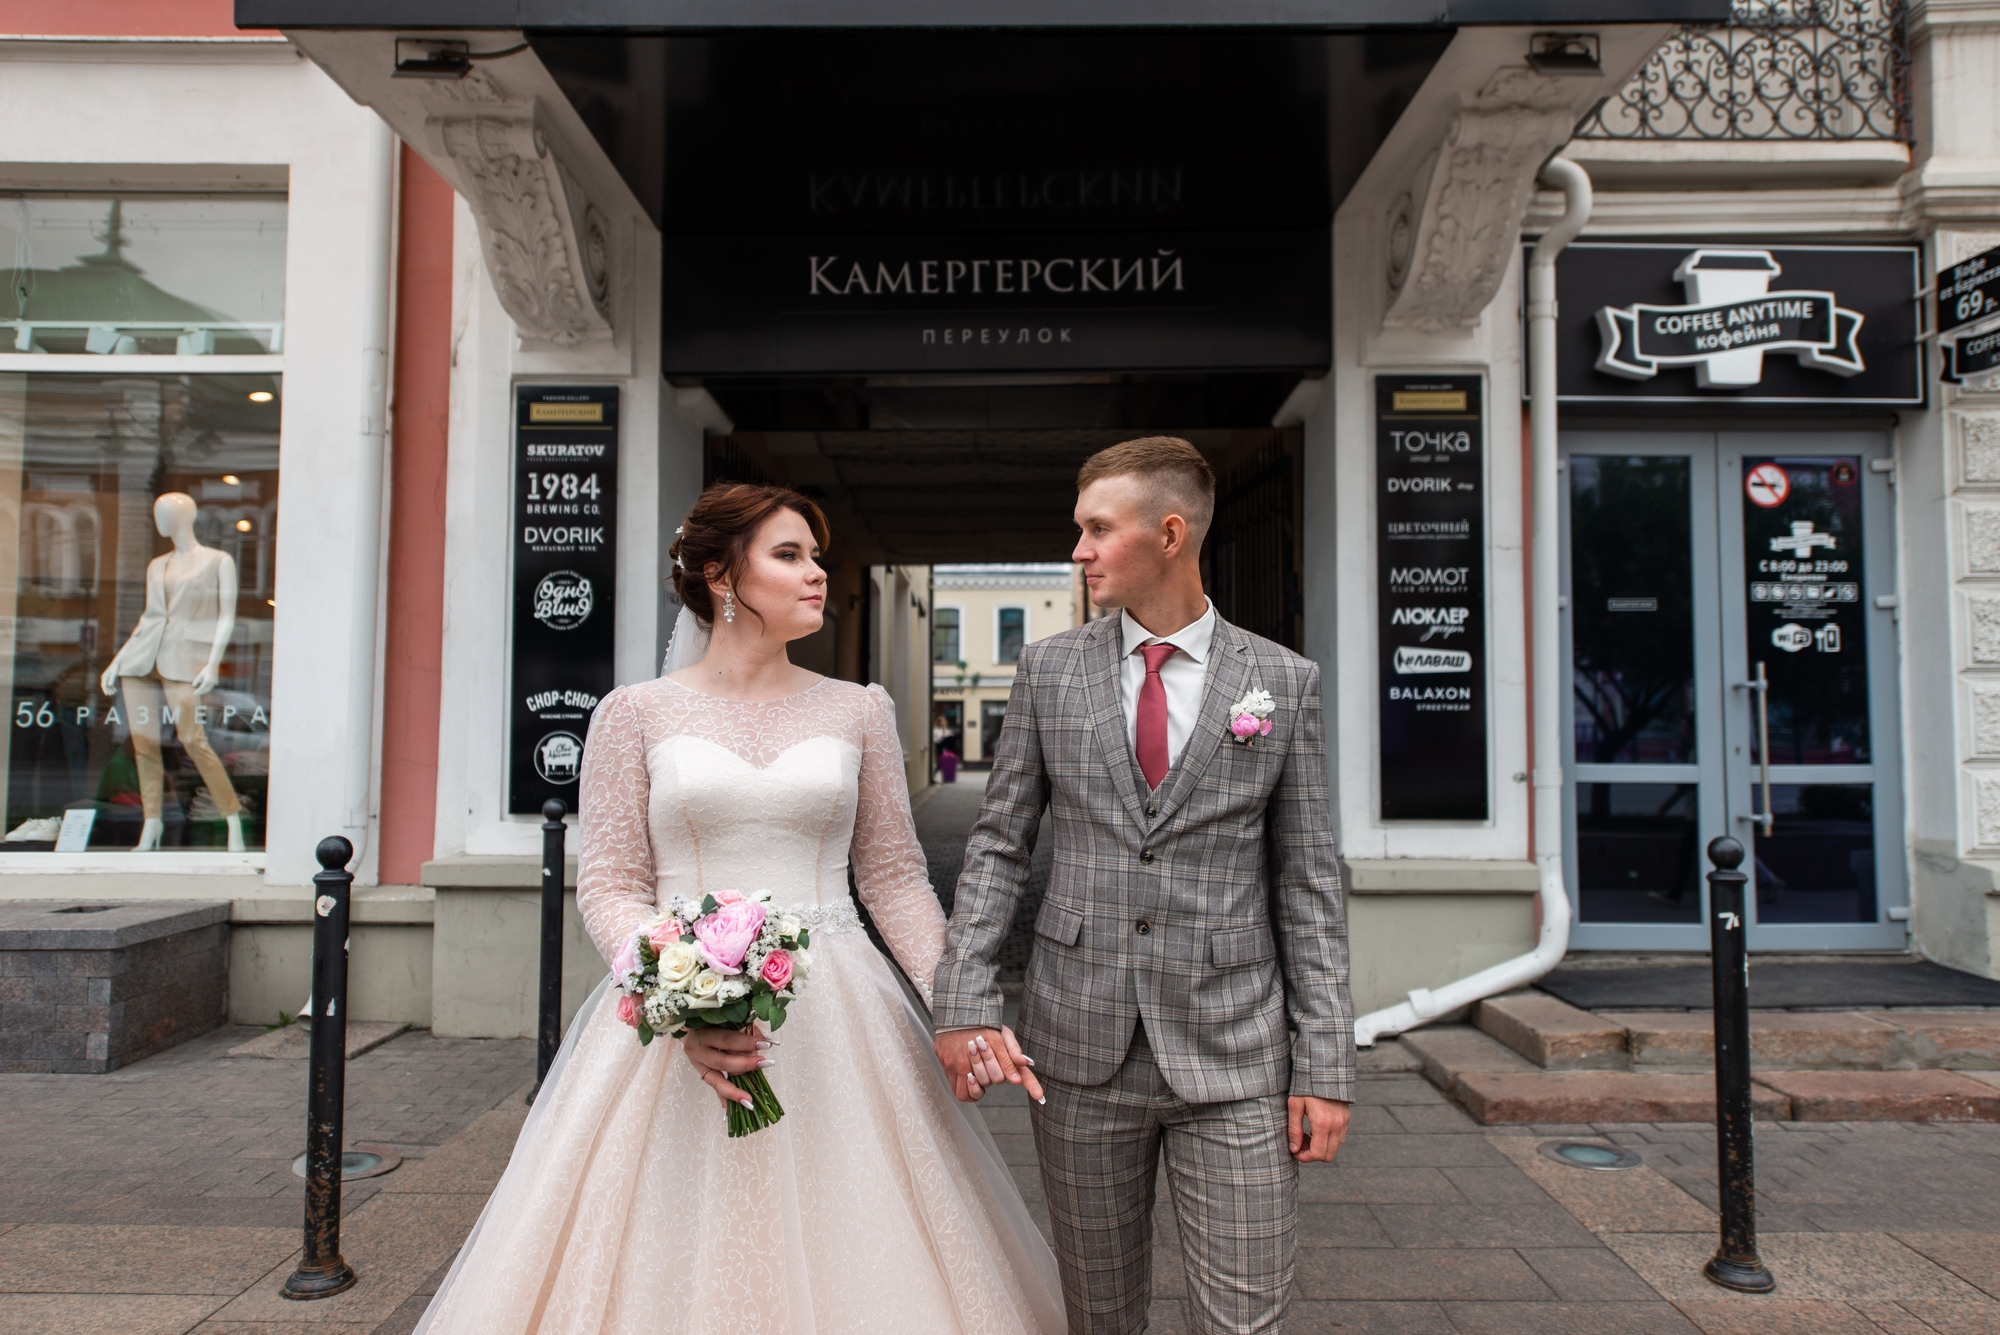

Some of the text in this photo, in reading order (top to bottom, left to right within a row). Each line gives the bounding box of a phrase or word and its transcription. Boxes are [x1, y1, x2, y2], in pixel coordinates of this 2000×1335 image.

[1956, 288, 1984, 321] 69
[1654, 300, 1814, 335] COFFEE ANYTIME
[922, 328, 1072, 344] ПЕРЕУЛОК
[1695, 322, 1780, 351] кофейня
[527, 444, 605, 456] SKURATOV
[527, 472, 601, 500] 1984
[1387, 477, 1452, 492] DVORIK
[527, 504, 600, 515] BREWING CO.
[1388, 518, 1470, 535] ЦВЕТОЧНЫЙ
[524, 527, 604, 544] DVORIK
[1815, 560, 1848, 573] 23:00
[1390, 567, 1469, 585] MOMOT
[1391, 585, 1469, 593] CLUB OF BEAUTY
[1392, 606, 1470, 625] ЛЮКЛЕР
[526, 690, 598, 712] CHOP-CHOP
[1390, 686, 1471, 700] BALAXON
[15, 701, 268, 728] 56 РАЗМЕРА
[1416, 703, 1471, 711] STREETWEAR
